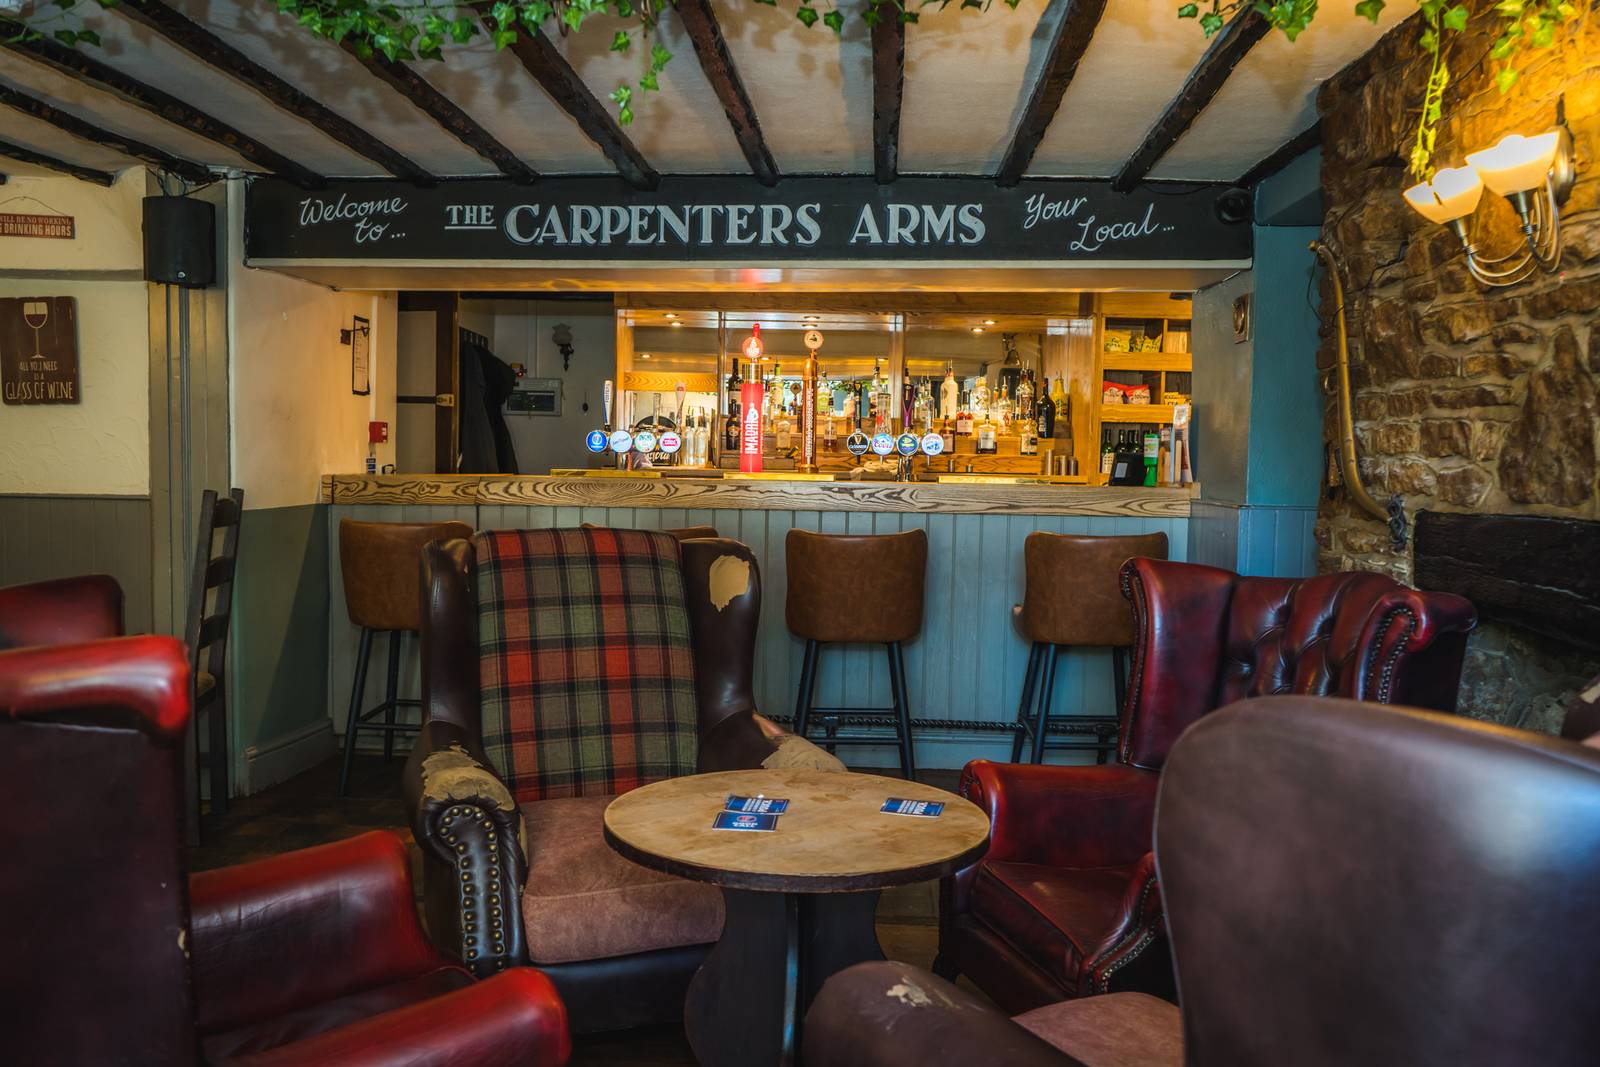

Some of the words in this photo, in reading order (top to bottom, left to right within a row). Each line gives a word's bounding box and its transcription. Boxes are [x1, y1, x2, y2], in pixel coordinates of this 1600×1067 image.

[27, 216, 37, 224] NO
[300, 193, 408, 225] Welcome
[1024, 193, 1088, 228] Your
[4, 223, 43, 235] DRINKING
[45, 225, 71, 236] HOURS
[446, 205, 494, 225] THE
[504, 203, 821, 245] CARPENTERS
[850, 203, 986, 244] ARMS
[5, 382, 32, 399] GLASS
[34, 382, 45, 399] OF
[47, 382, 73, 399] WINE
